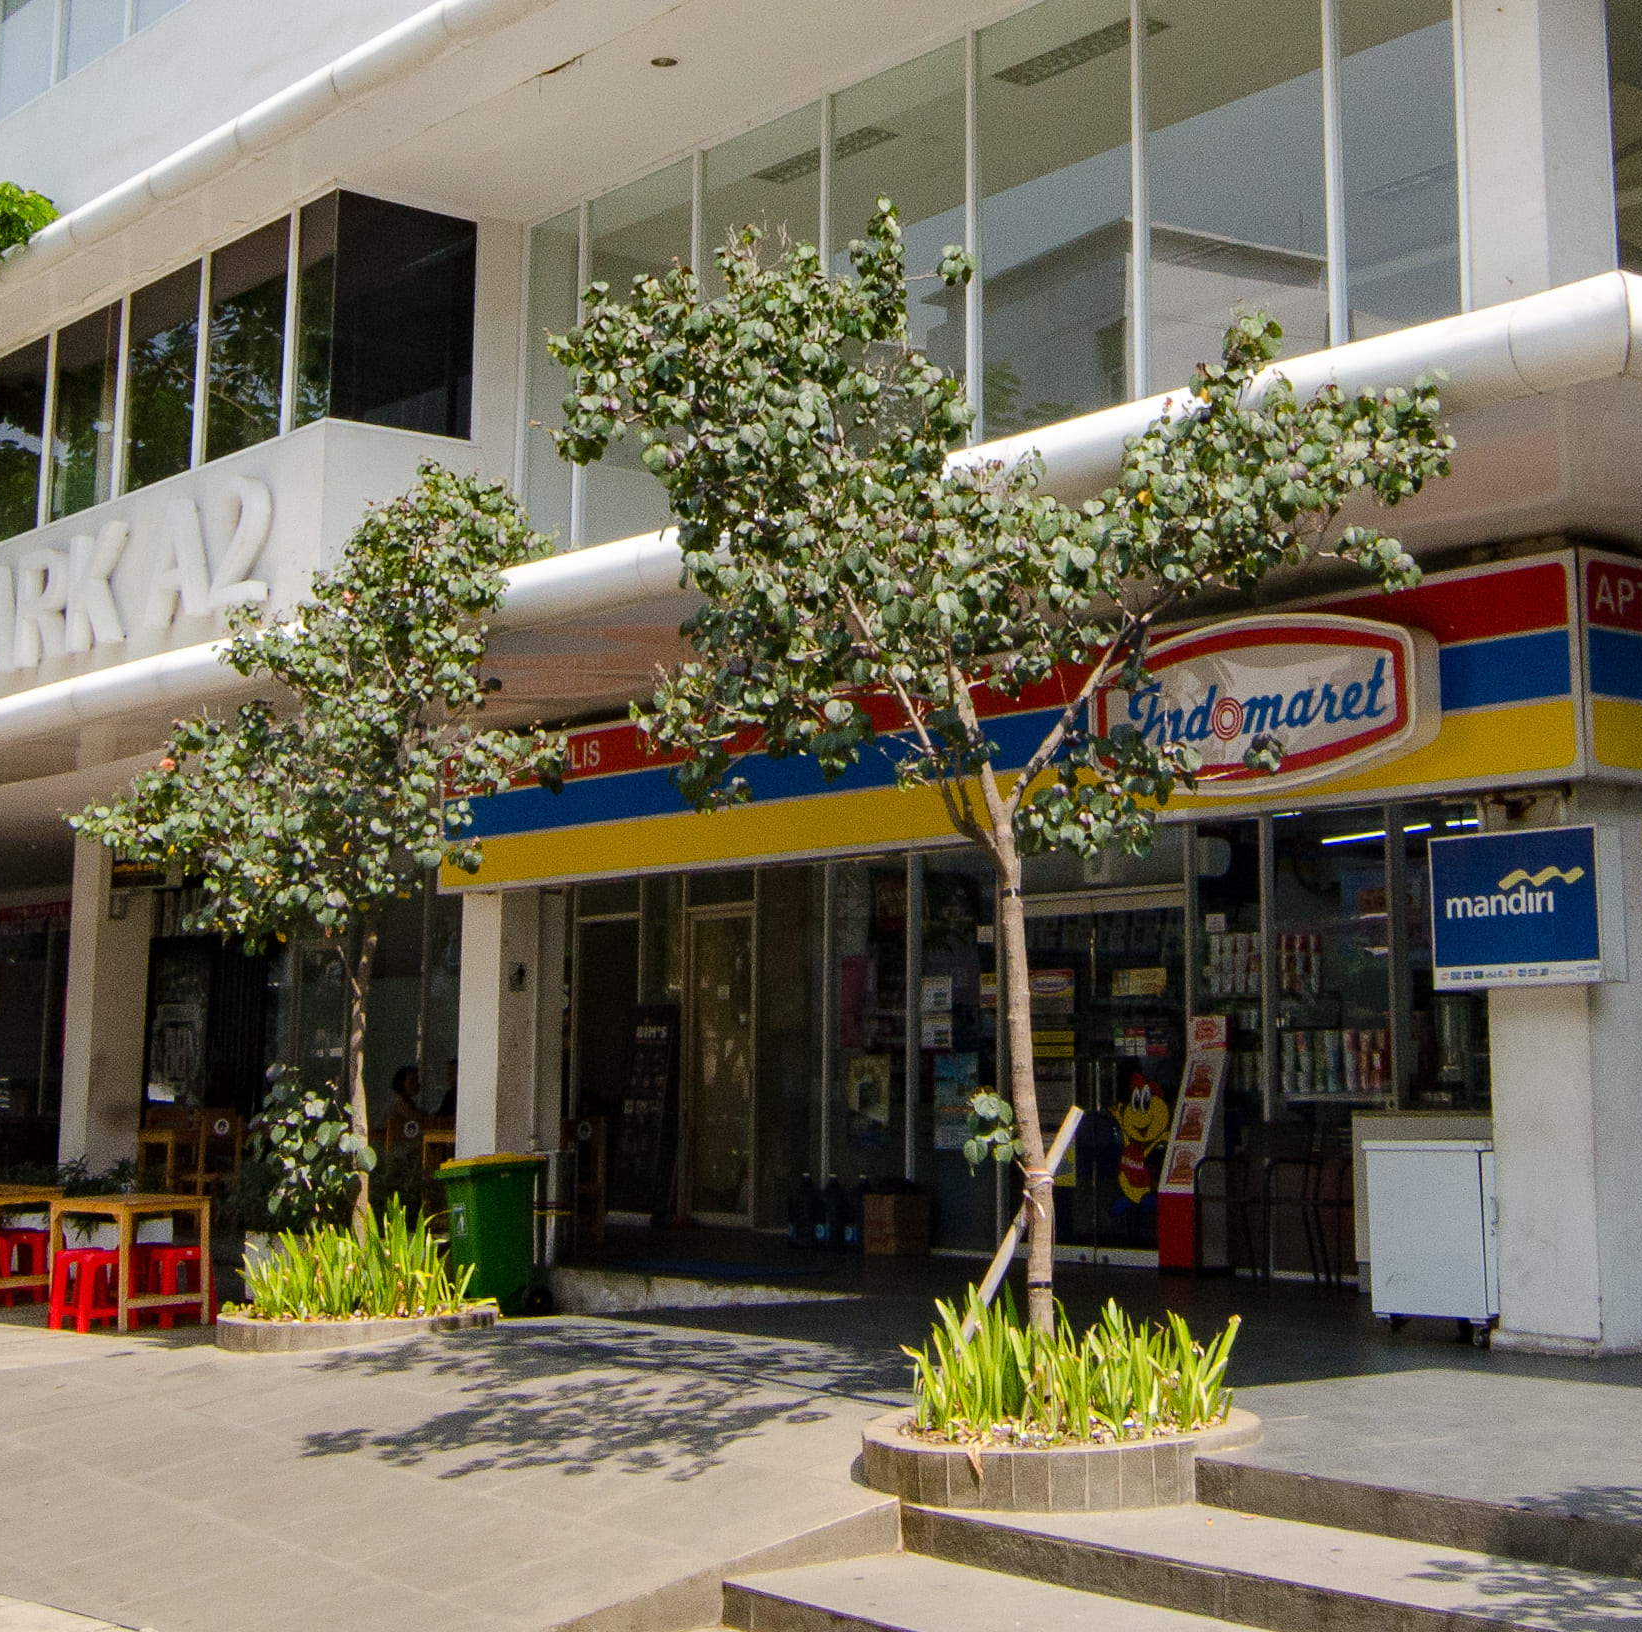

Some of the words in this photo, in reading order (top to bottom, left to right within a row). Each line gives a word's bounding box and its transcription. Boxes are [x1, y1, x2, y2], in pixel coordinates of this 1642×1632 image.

[143, 474, 271, 630] A2
[1127, 654, 1390, 747] Indomaret
[1445, 885, 1555, 920] mandiri
